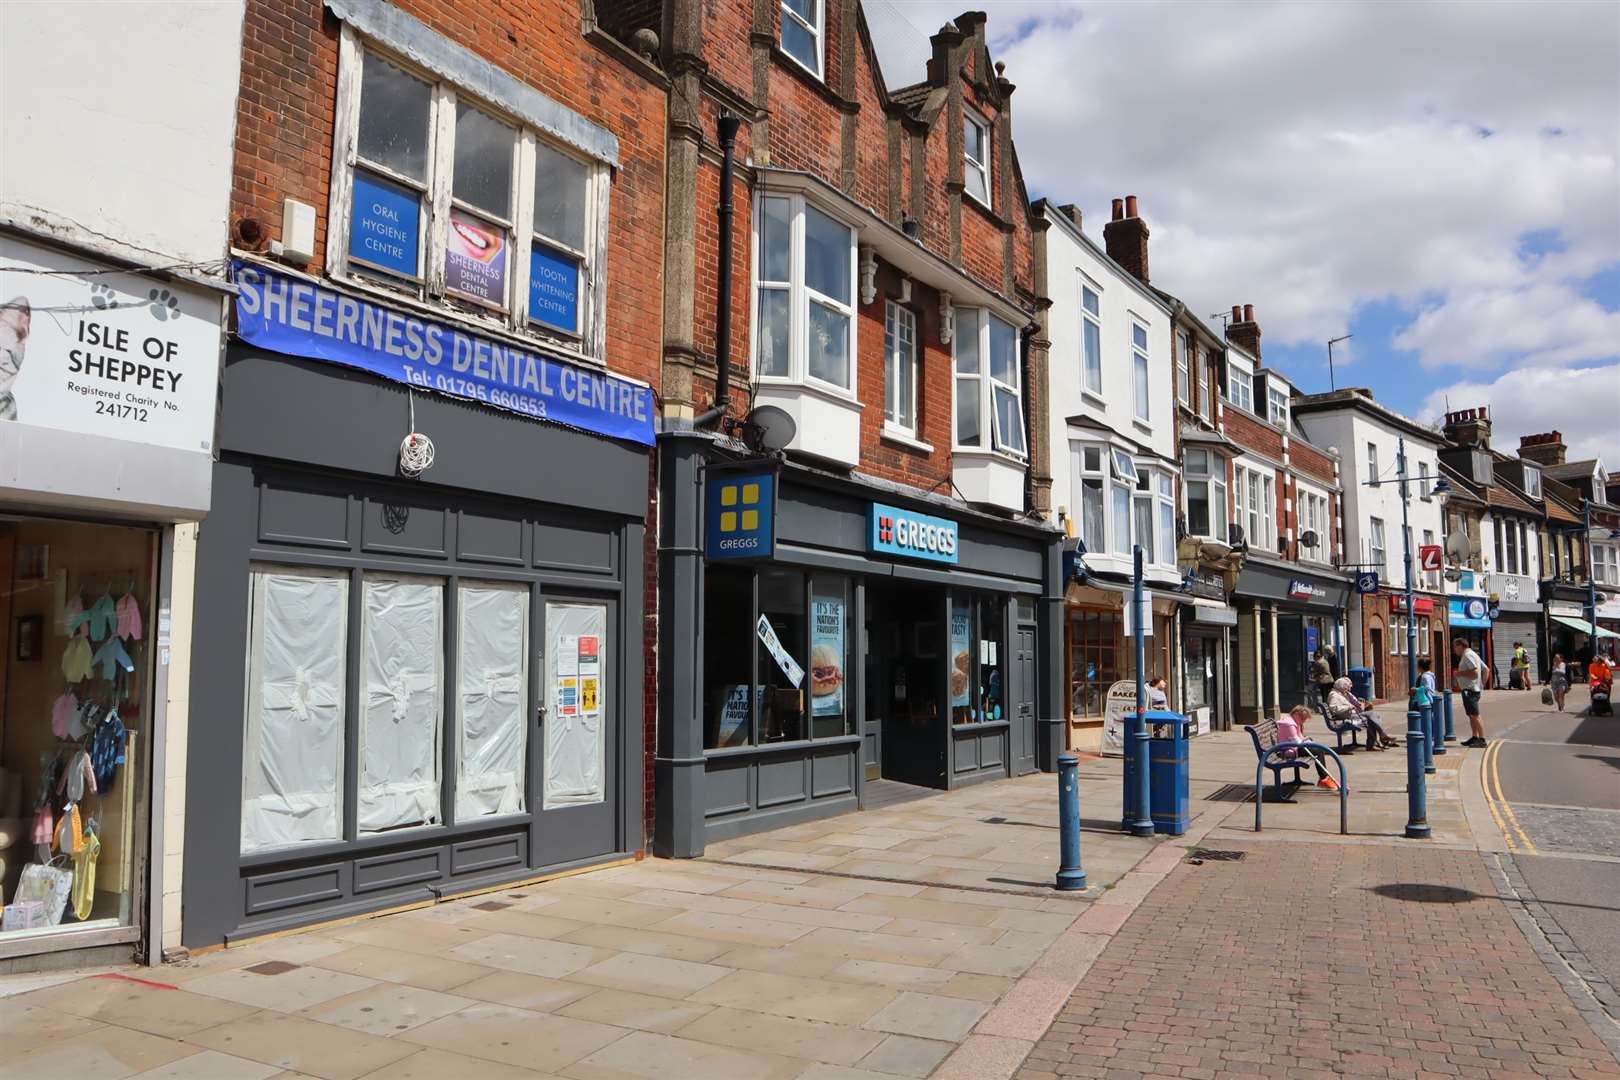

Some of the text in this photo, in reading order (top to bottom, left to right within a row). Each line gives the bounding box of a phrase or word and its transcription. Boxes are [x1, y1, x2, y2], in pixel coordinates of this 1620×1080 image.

[372, 203, 400, 222] ORAL
[362, 217, 407, 243] HYGIENE
[365, 237, 404, 260] CENTRE
[450, 254, 500, 280] SHEERNESS
[460, 270, 488, 286] DENTAL
[540, 266, 567, 285] TOOTH
[460, 281, 488, 298] CENTRE
[532, 278, 575, 303] WHITENING
[538, 296, 567, 314] CENTRE
[78, 320, 179, 362] ISLE OF
[238, 267, 647, 423] SHEERNESS DENTAL CENTRE
[68, 350, 183, 393] SHEPPEY
[403, 365, 431, 388] Tel:
[436, 374, 487, 400] 01795
[67, 381, 180, 411] Registered Charity No.
[95, 400, 148, 422] 241712
[719, 537, 758, 550] GREGGS
[896, 517, 956, 556] GREGGS
